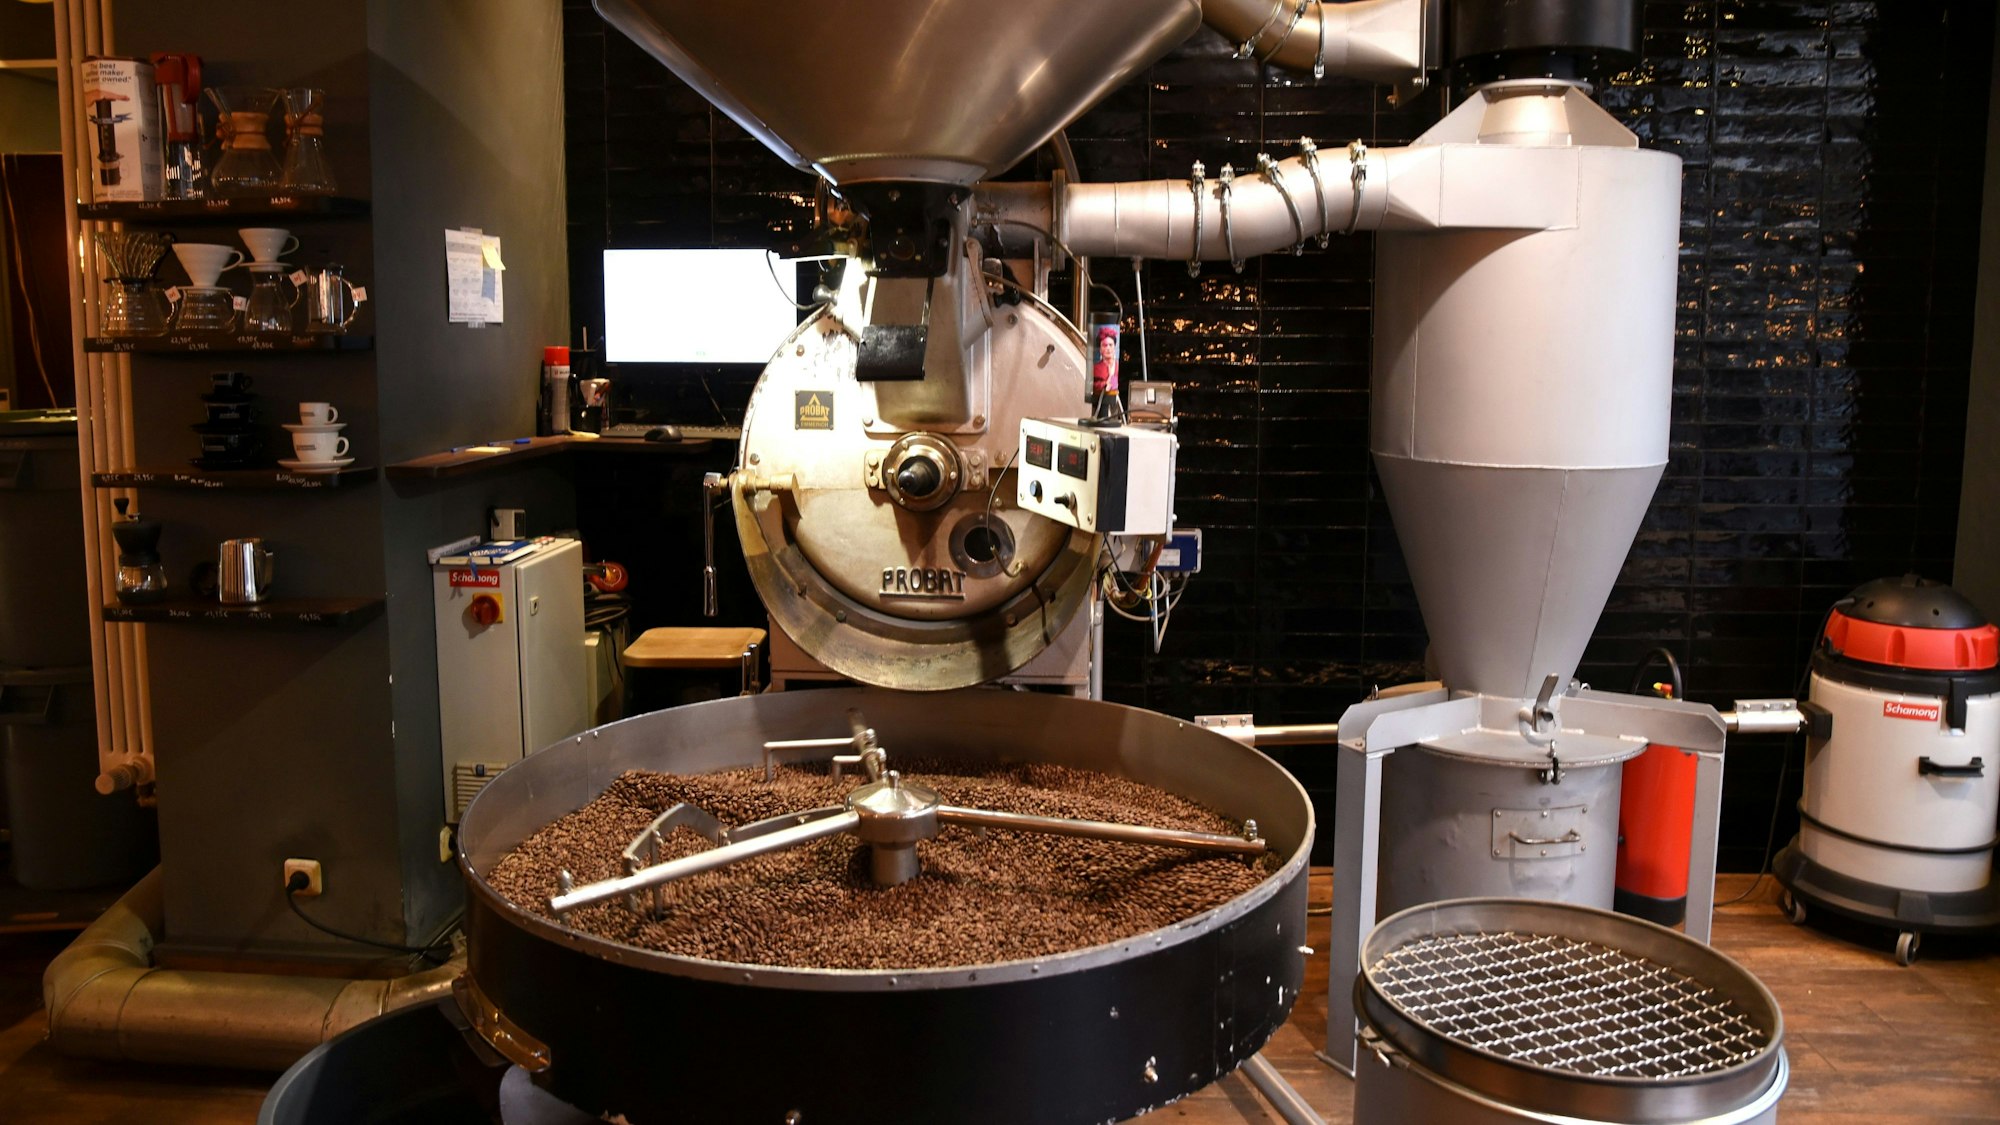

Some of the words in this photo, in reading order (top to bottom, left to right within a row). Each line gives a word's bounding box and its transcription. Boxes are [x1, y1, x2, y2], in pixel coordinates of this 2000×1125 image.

[800, 404, 830, 416] PROBAT
[882, 566, 966, 593] PROBAT
[1885, 703, 1938, 719] Schamong
